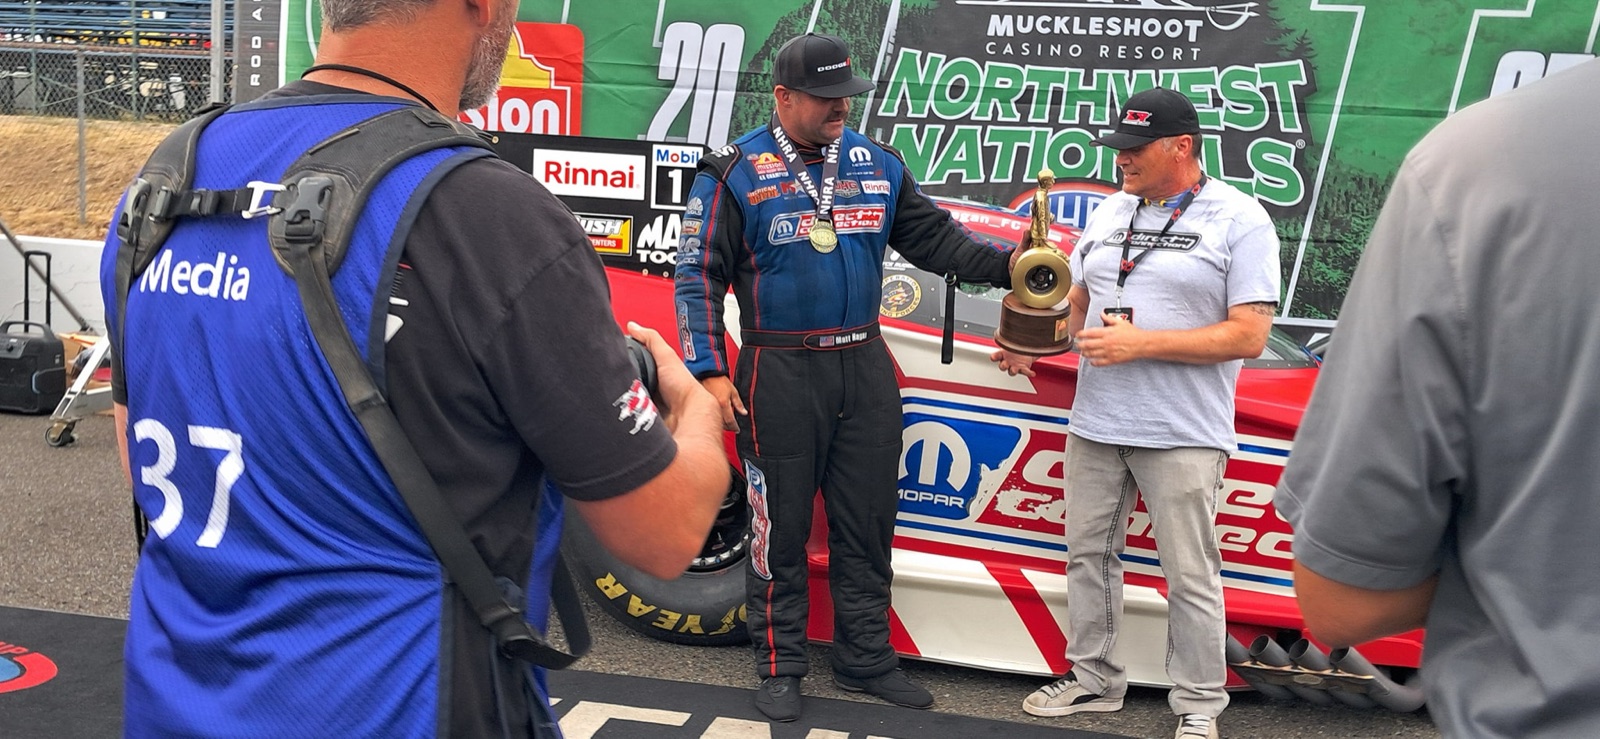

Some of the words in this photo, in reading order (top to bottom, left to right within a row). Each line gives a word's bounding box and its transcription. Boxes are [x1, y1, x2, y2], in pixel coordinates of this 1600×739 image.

[252, 0, 263, 21] A
[986, 14, 1204, 43] MUCKLESHOOT
[250, 36, 262, 87] ROD
[985, 42, 1083, 58] CASINO
[1099, 45, 1201, 61] RESORT
[656, 149, 700, 164] Mobil
[773, 126, 797, 163] NHRA
[544, 161, 634, 189] Rinnai
[889, 123, 1305, 207] NATIOLS
[668, 168, 682, 204] 1
[820, 176, 836, 215] NHRA
[801, 211, 873, 227] dect
[591, 239, 617, 248] ENTERS
[139, 249, 250, 301] Media
[133, 418, 245, 548] 37
